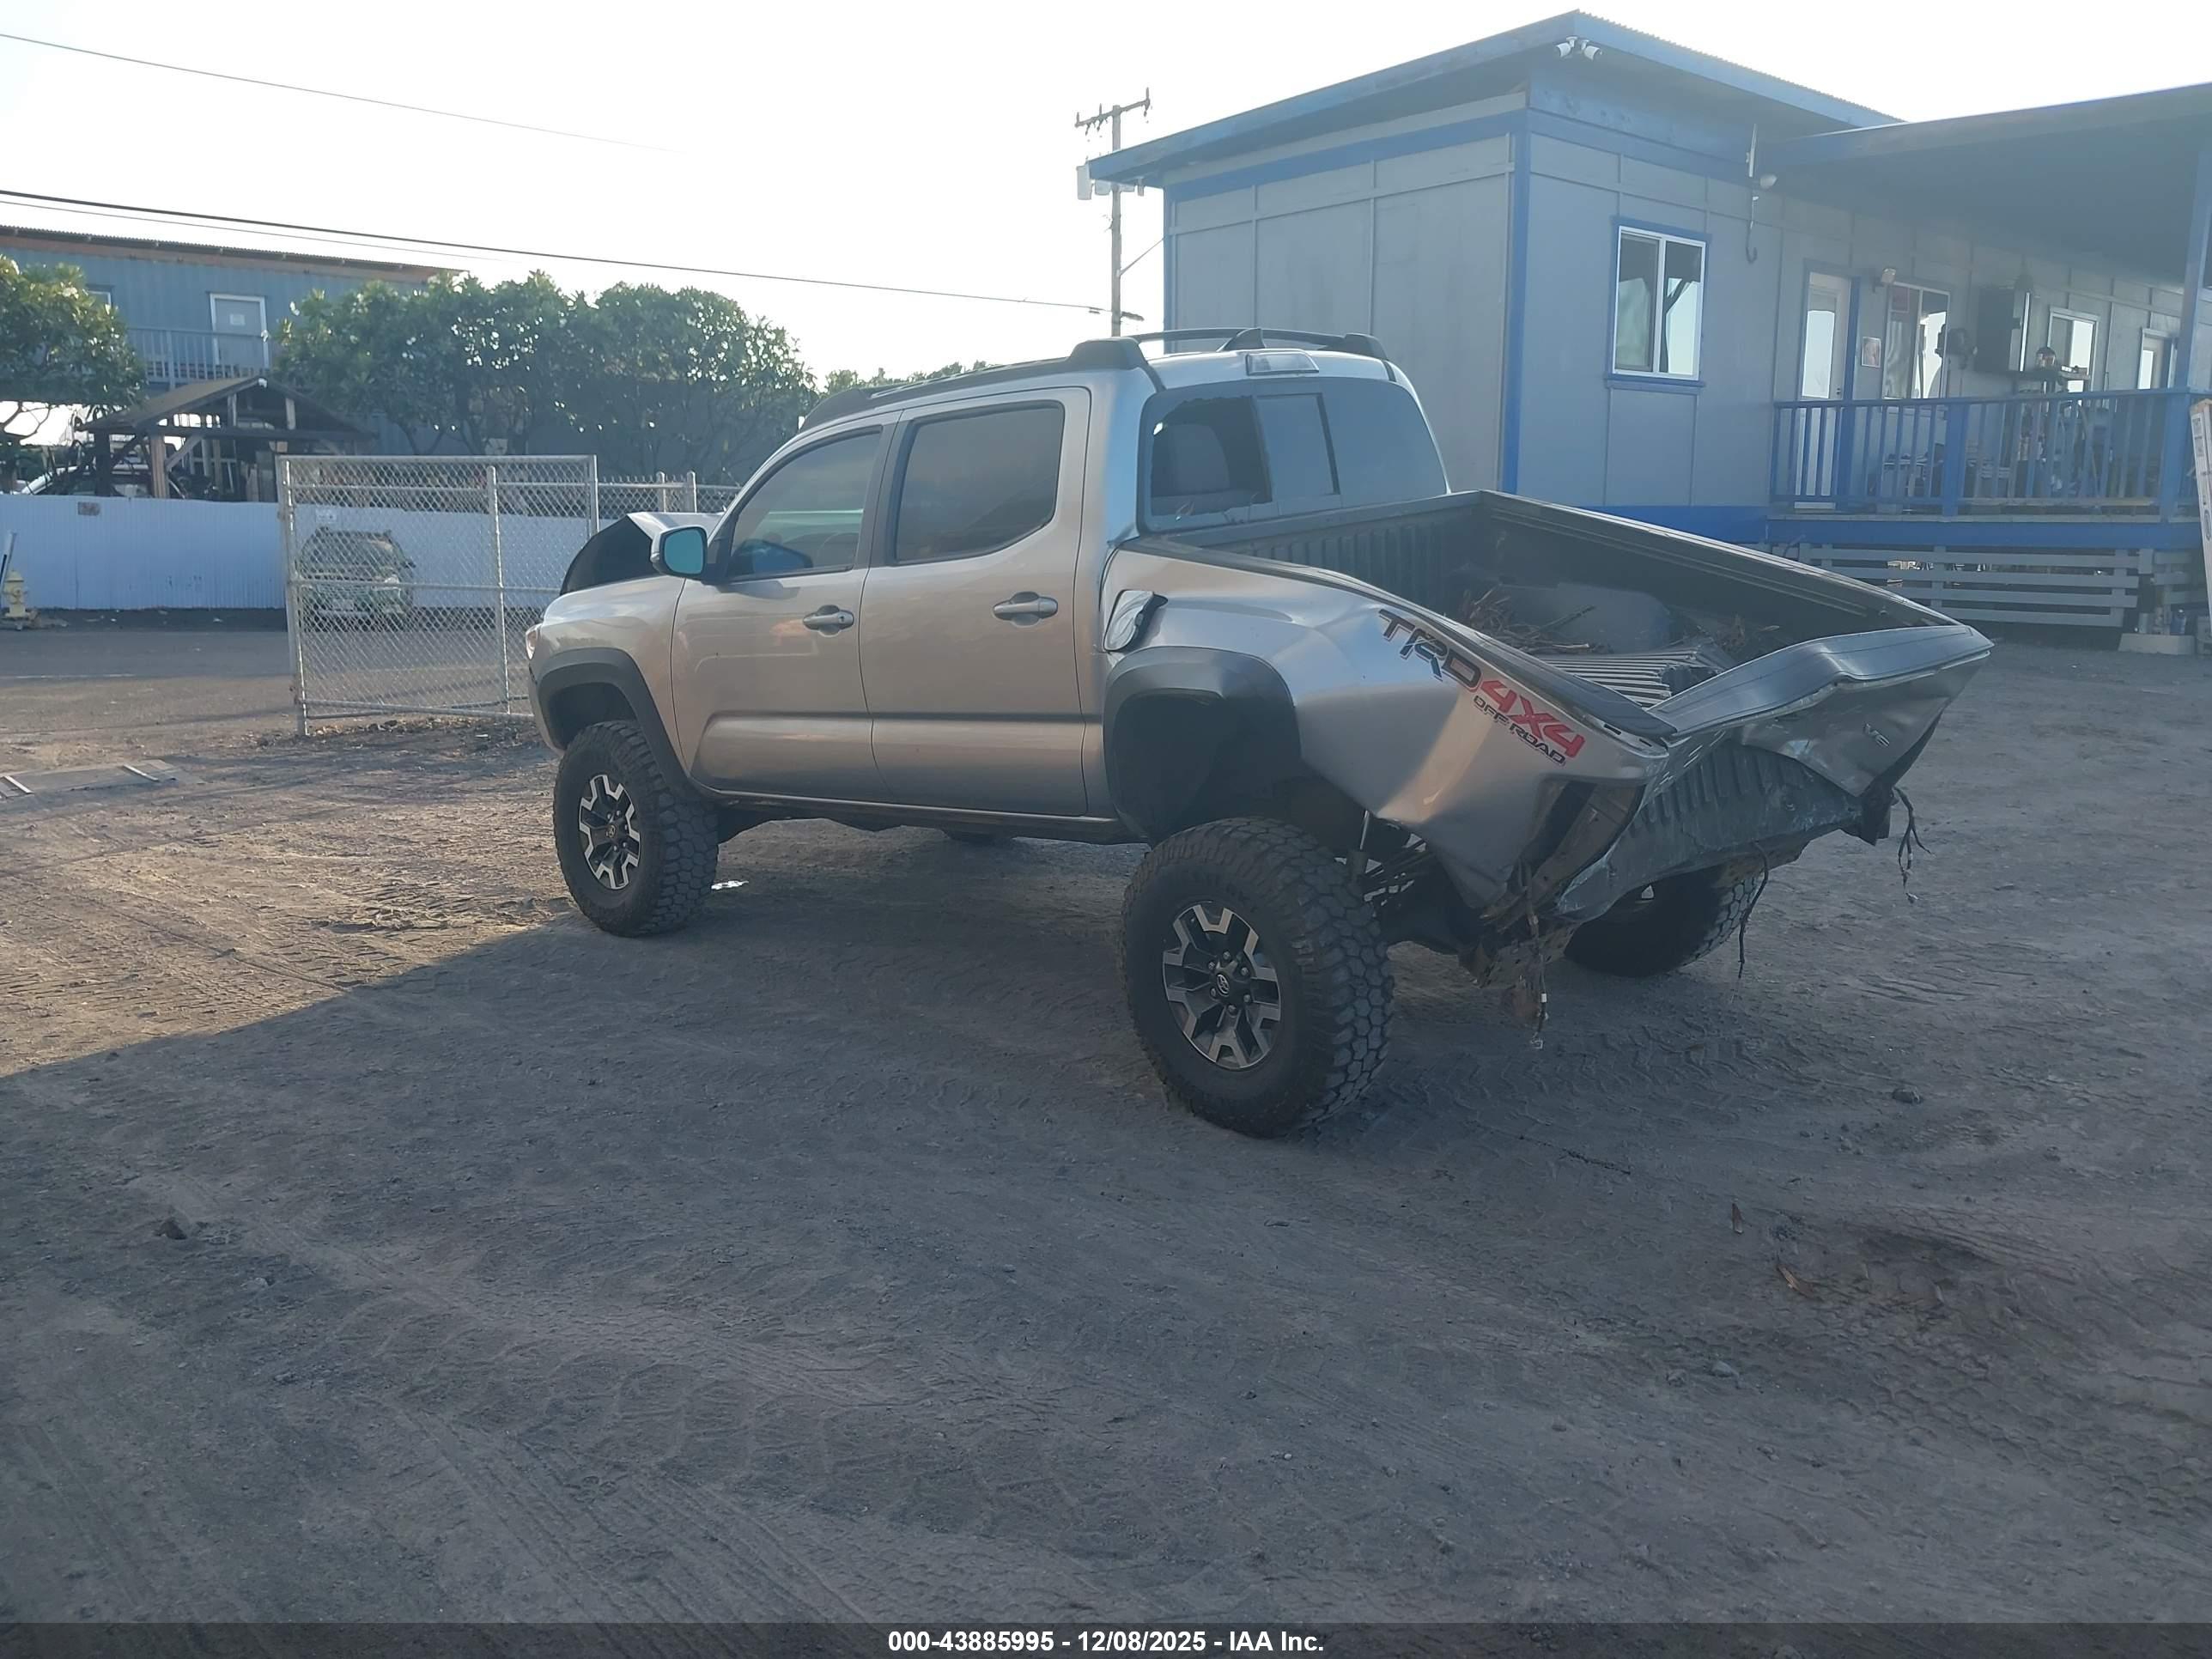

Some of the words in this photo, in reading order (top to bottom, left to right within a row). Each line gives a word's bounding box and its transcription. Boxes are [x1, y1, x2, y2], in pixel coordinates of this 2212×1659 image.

[1378, 609, 1482, 691] TRD
[1480, 679, 1586, 758] 4X4
[1474, 696, 1510, 723] OFF
[1509, 723, 1566, 765] ROAD
